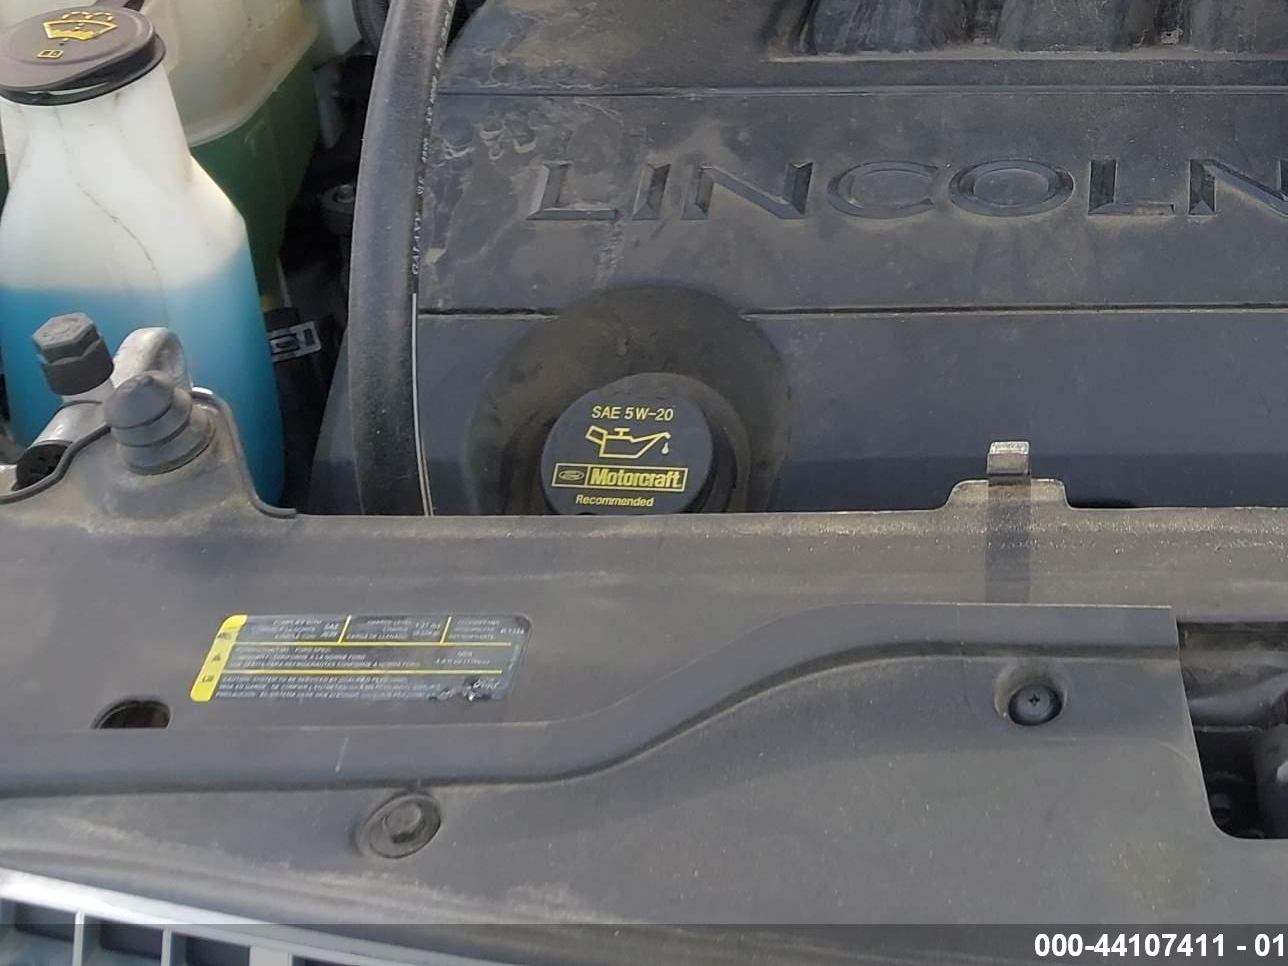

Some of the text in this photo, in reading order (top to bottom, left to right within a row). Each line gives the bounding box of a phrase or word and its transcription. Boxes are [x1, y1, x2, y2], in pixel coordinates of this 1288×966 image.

[591, 406, 674, 422] SAE 5W-20
[589, 468, 681, 488] Motorcraft
[575, 494, 654, 507] Recommended
